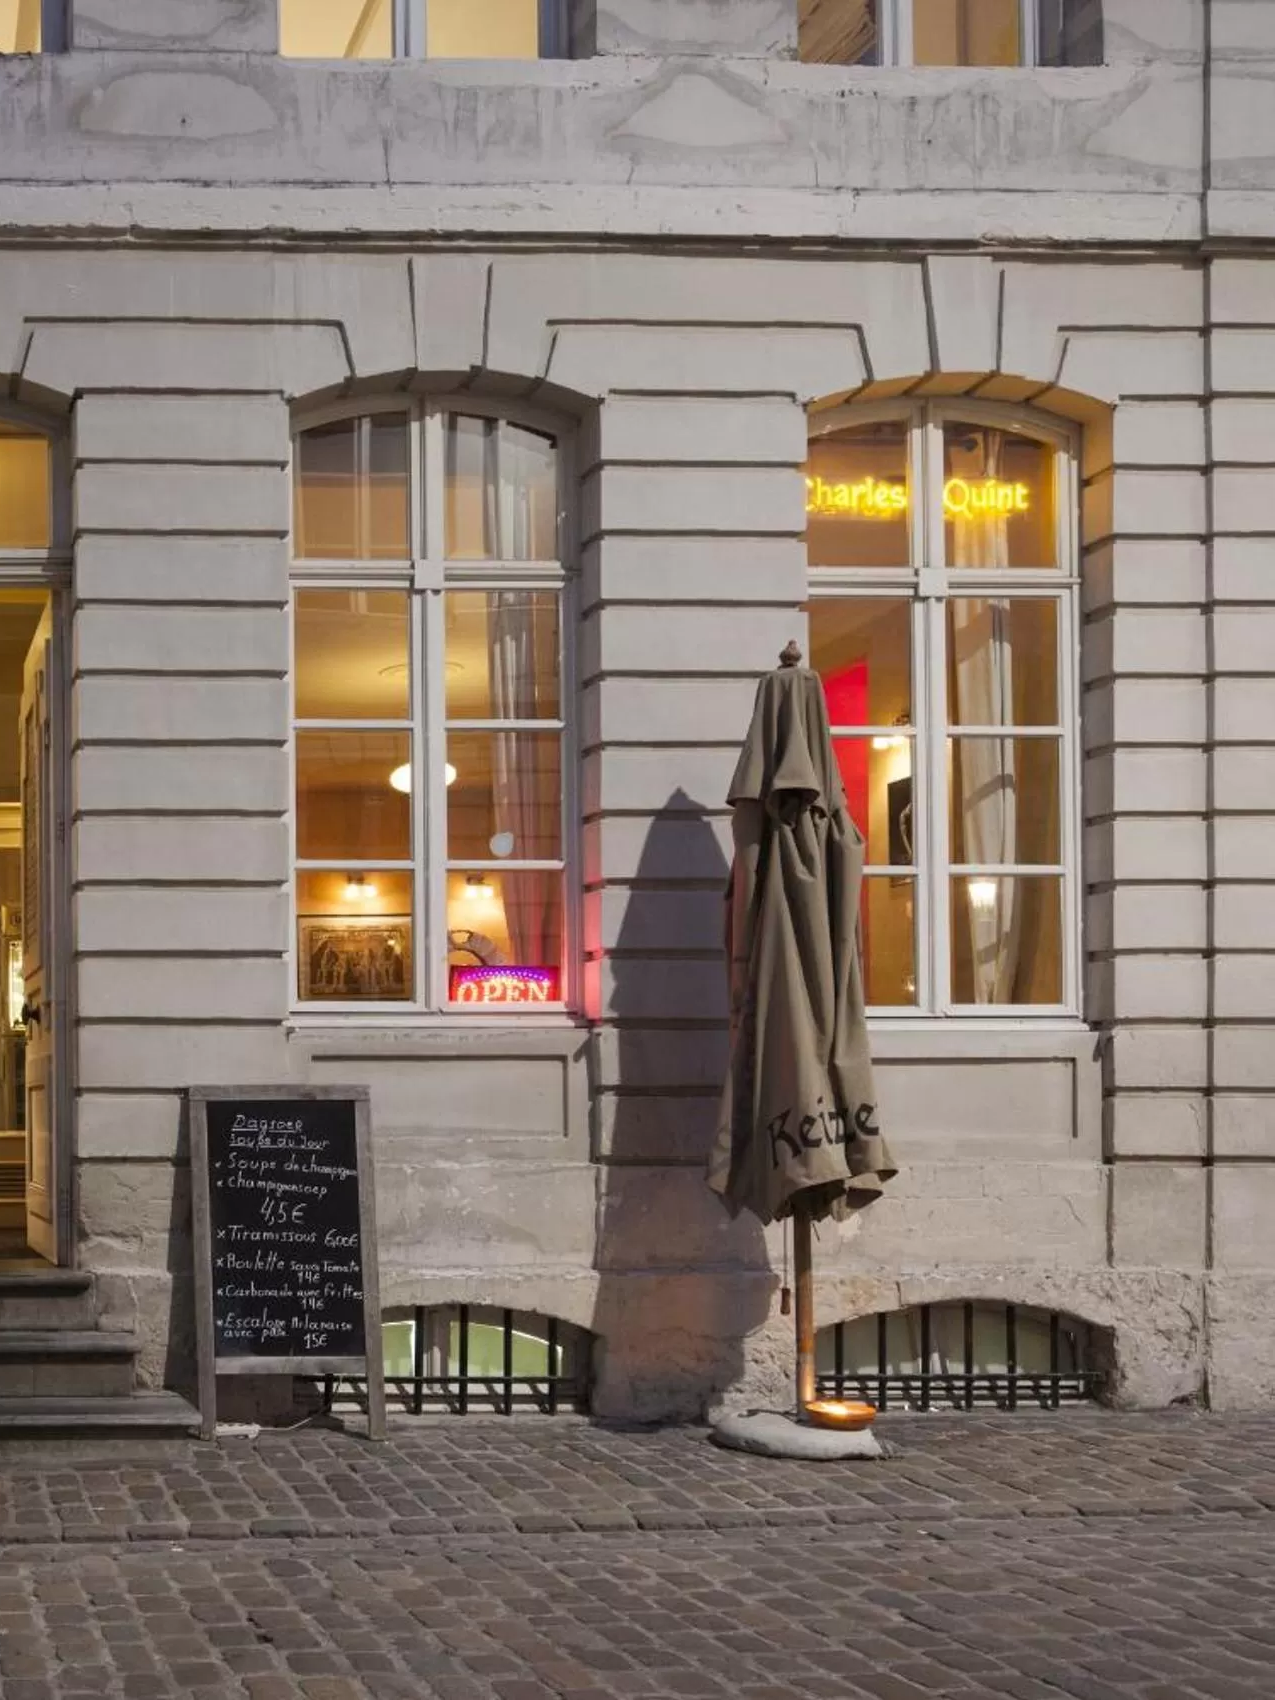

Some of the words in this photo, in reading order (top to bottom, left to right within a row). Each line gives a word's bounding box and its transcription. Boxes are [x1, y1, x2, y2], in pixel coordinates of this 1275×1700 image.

[943, 478, 1030, 520] Quint
[457, 980, 549, 1003] OPEN
[303, 1332, 328, 1349] 15€
